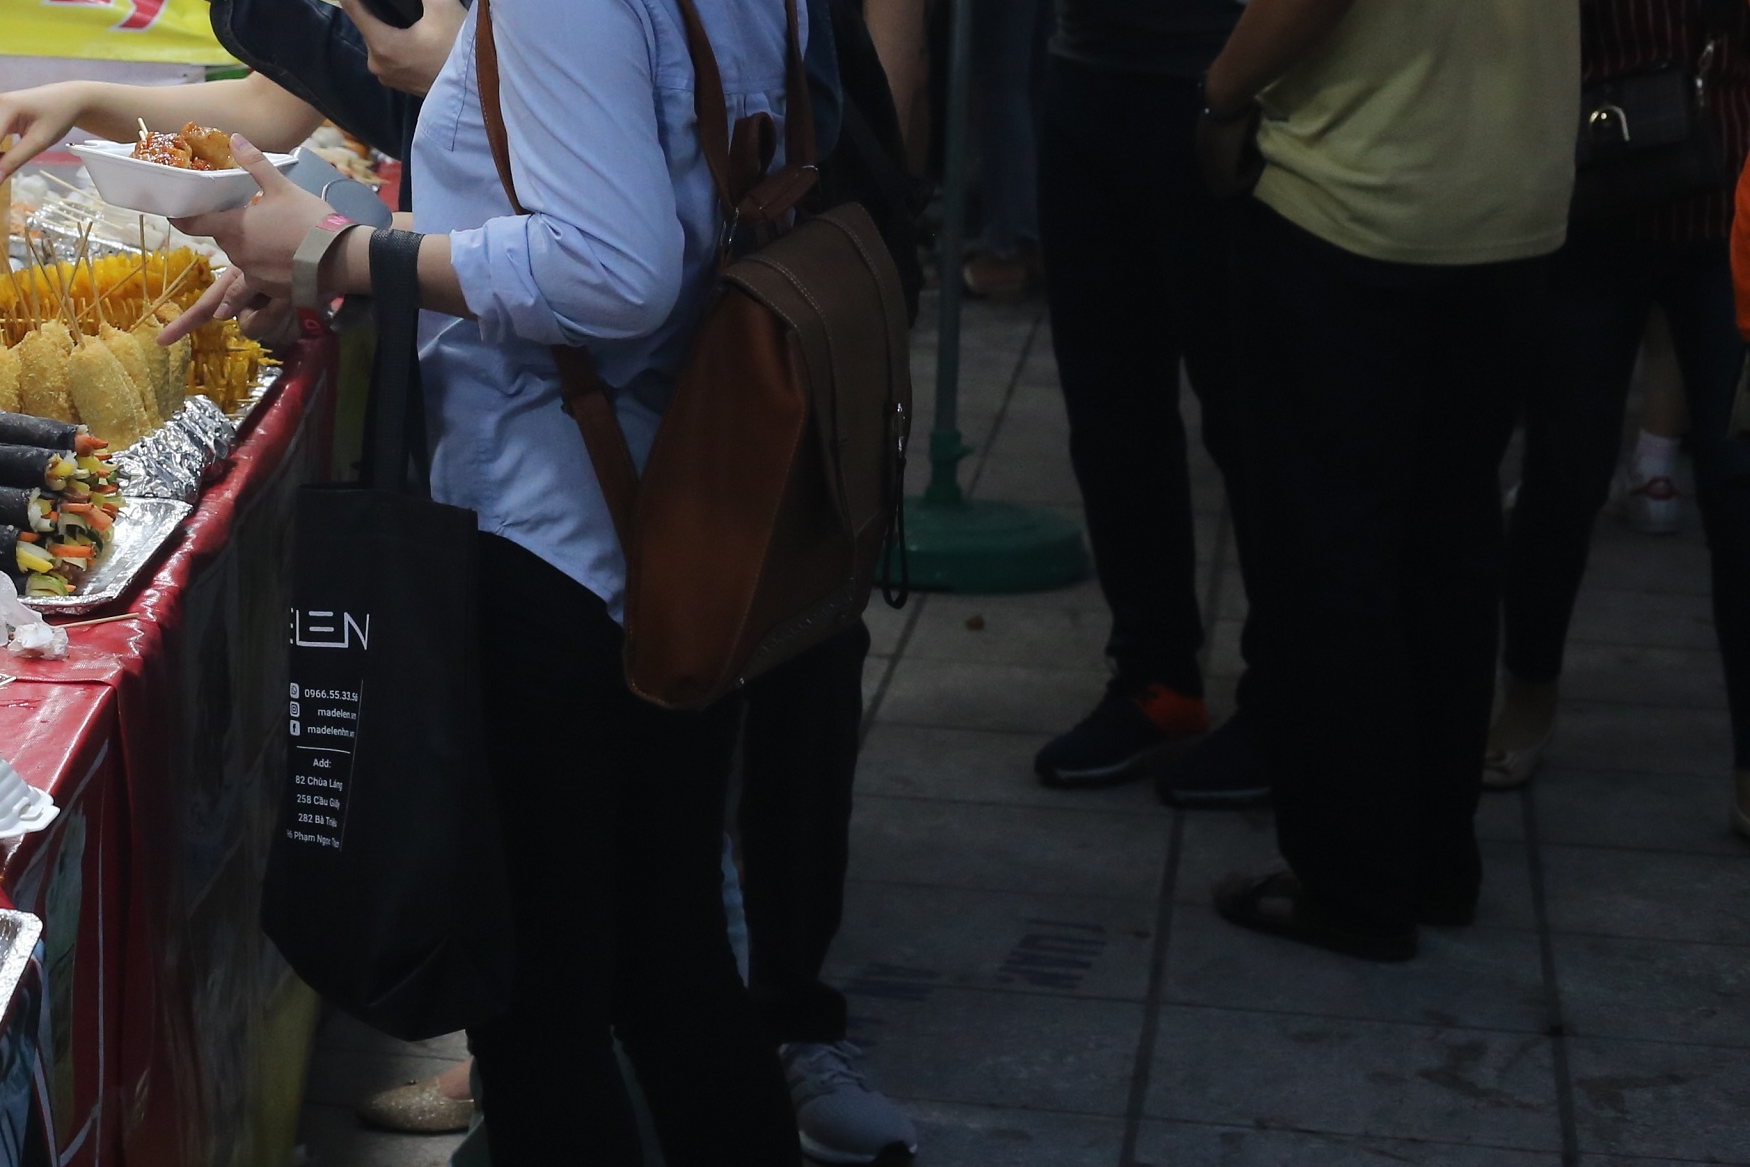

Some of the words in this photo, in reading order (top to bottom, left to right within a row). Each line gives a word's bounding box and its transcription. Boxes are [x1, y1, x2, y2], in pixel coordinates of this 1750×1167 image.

[290, 607, 370, 651] LEN
[312, 758, 332, 769] Add:
[295, 775, 306, 785] 82
[296, 794, 312, 805] 258
[298, 813, 314, 823] 282
[315, 815, 325, 825] Bà
[293, 831, 316, 843] Phạm
